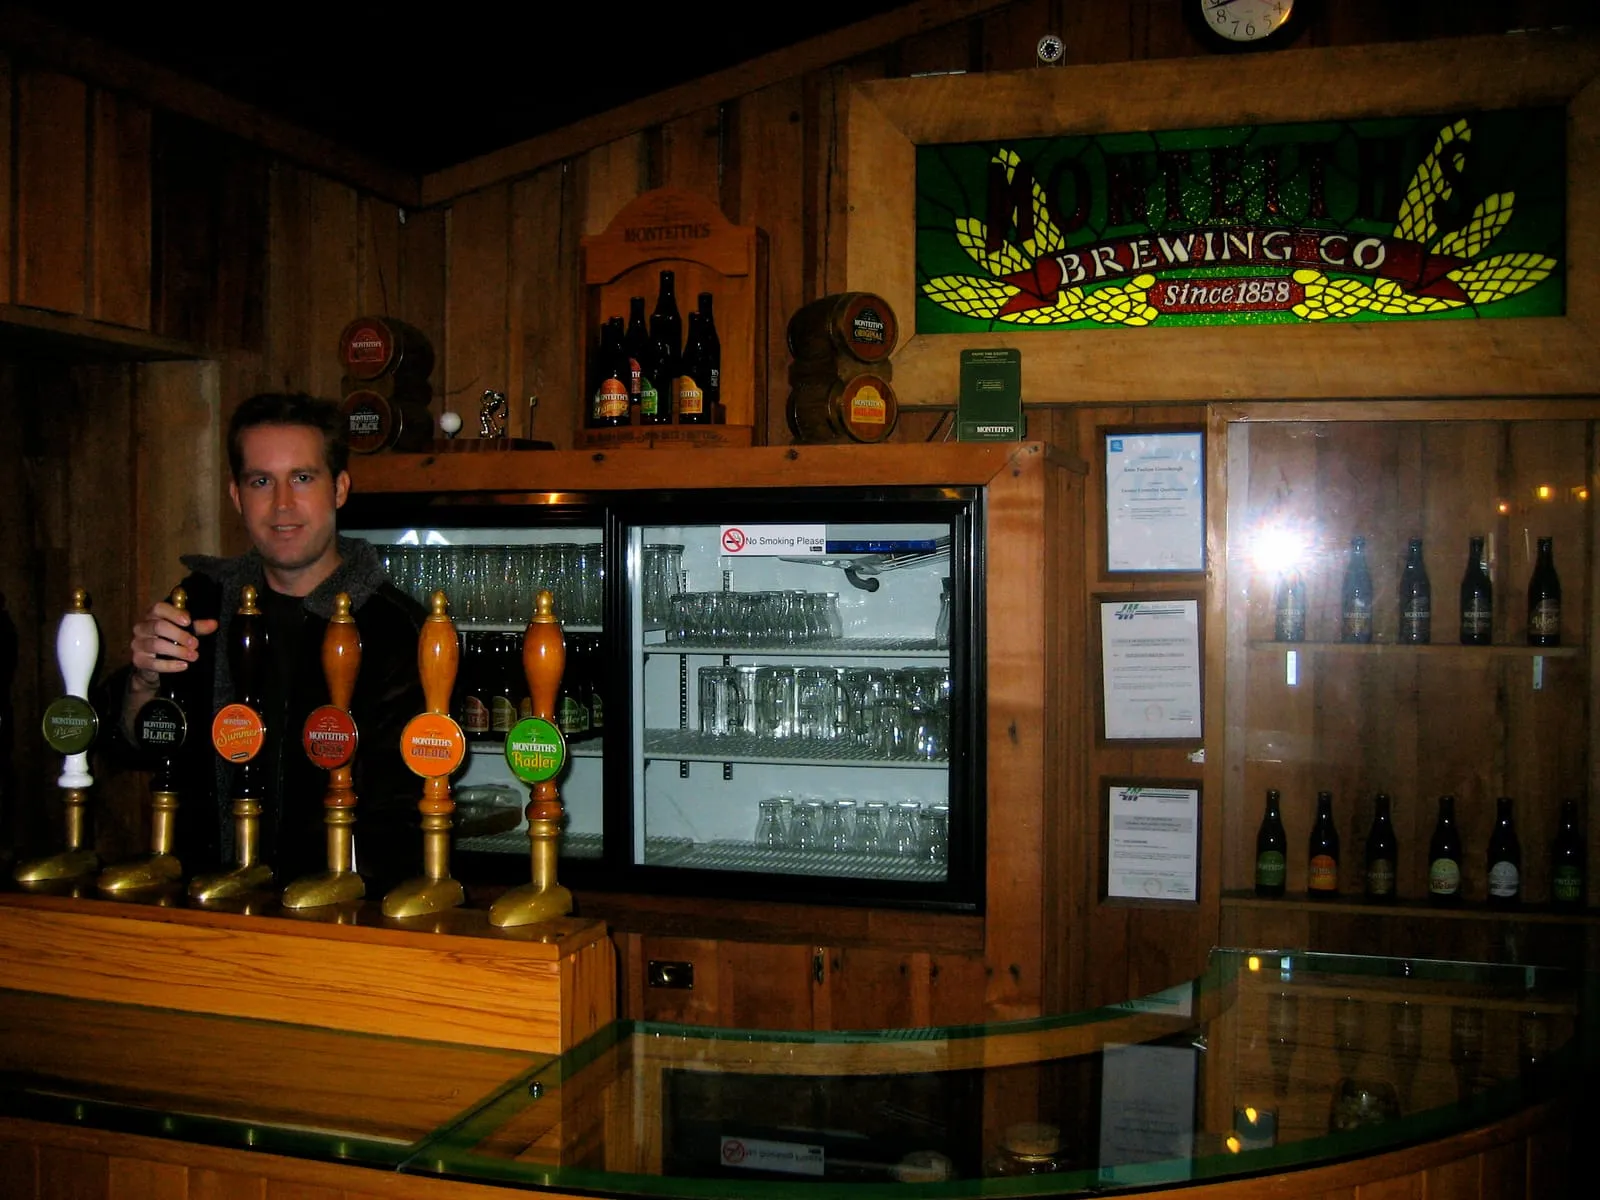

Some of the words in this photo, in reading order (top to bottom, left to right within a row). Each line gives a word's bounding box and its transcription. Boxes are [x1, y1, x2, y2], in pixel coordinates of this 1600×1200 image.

[1216, 9, 1226, 24] 8
[1263, 15, 1272, 29] 5
[1231, 21, 1240, 36] 7
[1246, 23, 1255, 36] 6
[1057, 230, 1293, 286] BREWING
[1319, 235, 1387, 271] CO
[1235, 281, 1290, 304] 1858
[746, 536, 758, 545] No
[759, 536, 795, 547] Smoking
[796, 536, 825, 545] Please
[142, 729, 176, 741] BLACK
[308, 731, 350, 742] MONTEITH'S
[411, 736, 453, 748] MONTEITH'S
[512, 741, 557, 753] MONTEITH'S
[512, 751, 556, 769] Radler
